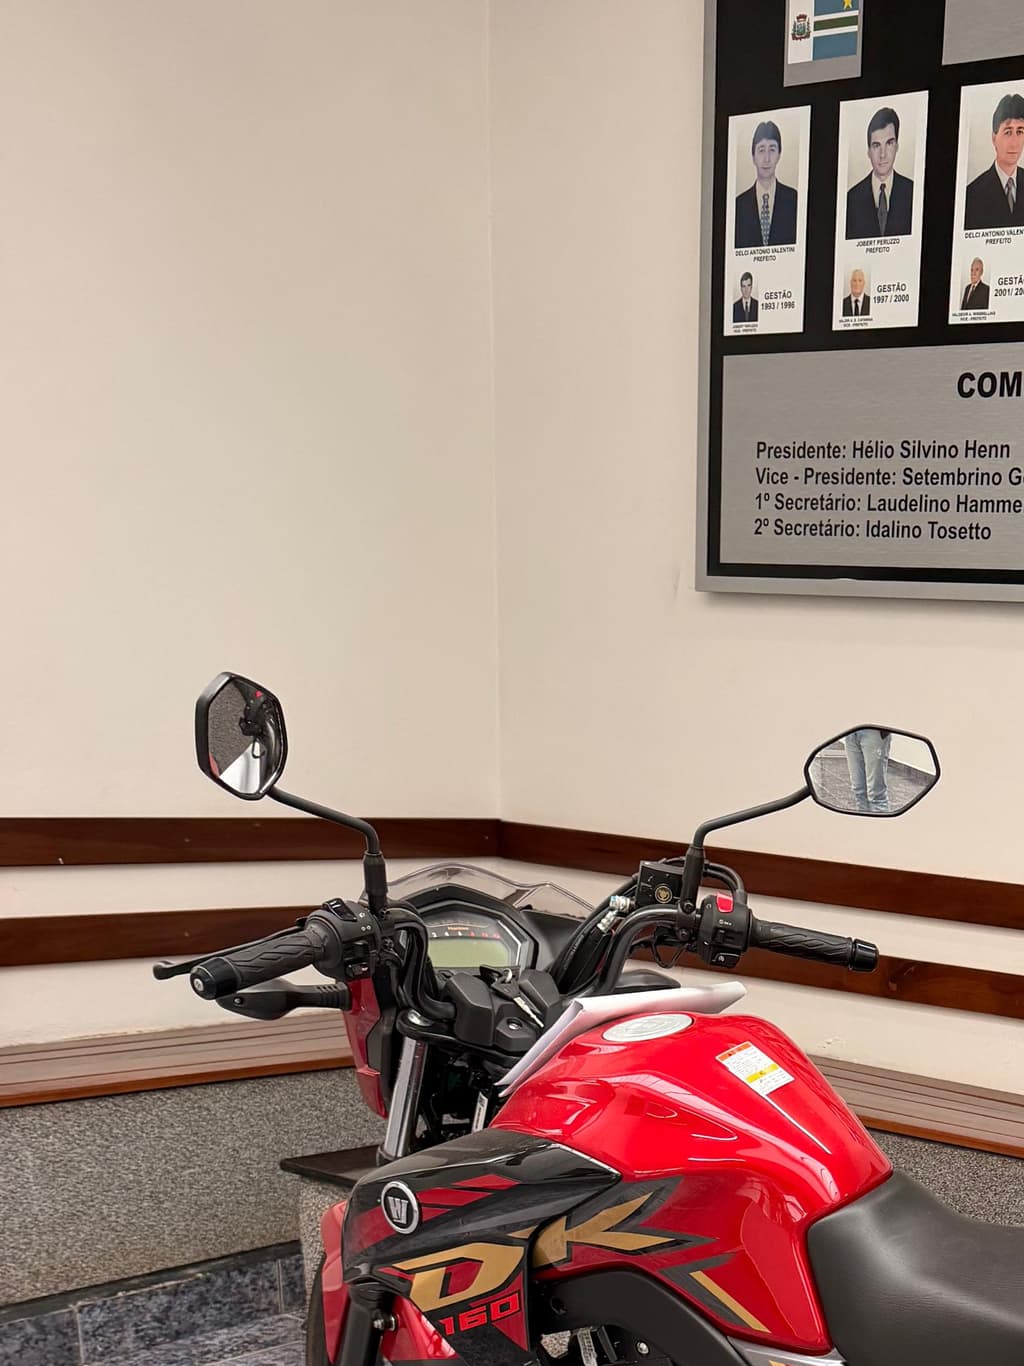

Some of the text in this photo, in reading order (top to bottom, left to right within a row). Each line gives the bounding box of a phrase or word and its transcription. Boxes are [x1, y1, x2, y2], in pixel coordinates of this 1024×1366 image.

[985, 237, 1012, 245] PREFEITO
[764, 290, 792, 300] GESTÃO
[877, 282, 907, 293] GESTÃO
[756, 439, 1010, 459] Presidente: Hélio Silvino Henn
[756, 467, 788, 485] Vice
[804, 467, 896, 485] Presidente:
[902, 467, 1002, 486] Setembrino
[755, 492, 770, 510] 1º
[774, 492, 861, 511] Secretário:
[867, 493, 950, 513] Laudelino
[754, 518, 991, 540] 2º Secretário: Idalino Tosetto
[392, 1191, 675, 1313] DK
[440, 1293, 521, 1336] 160
